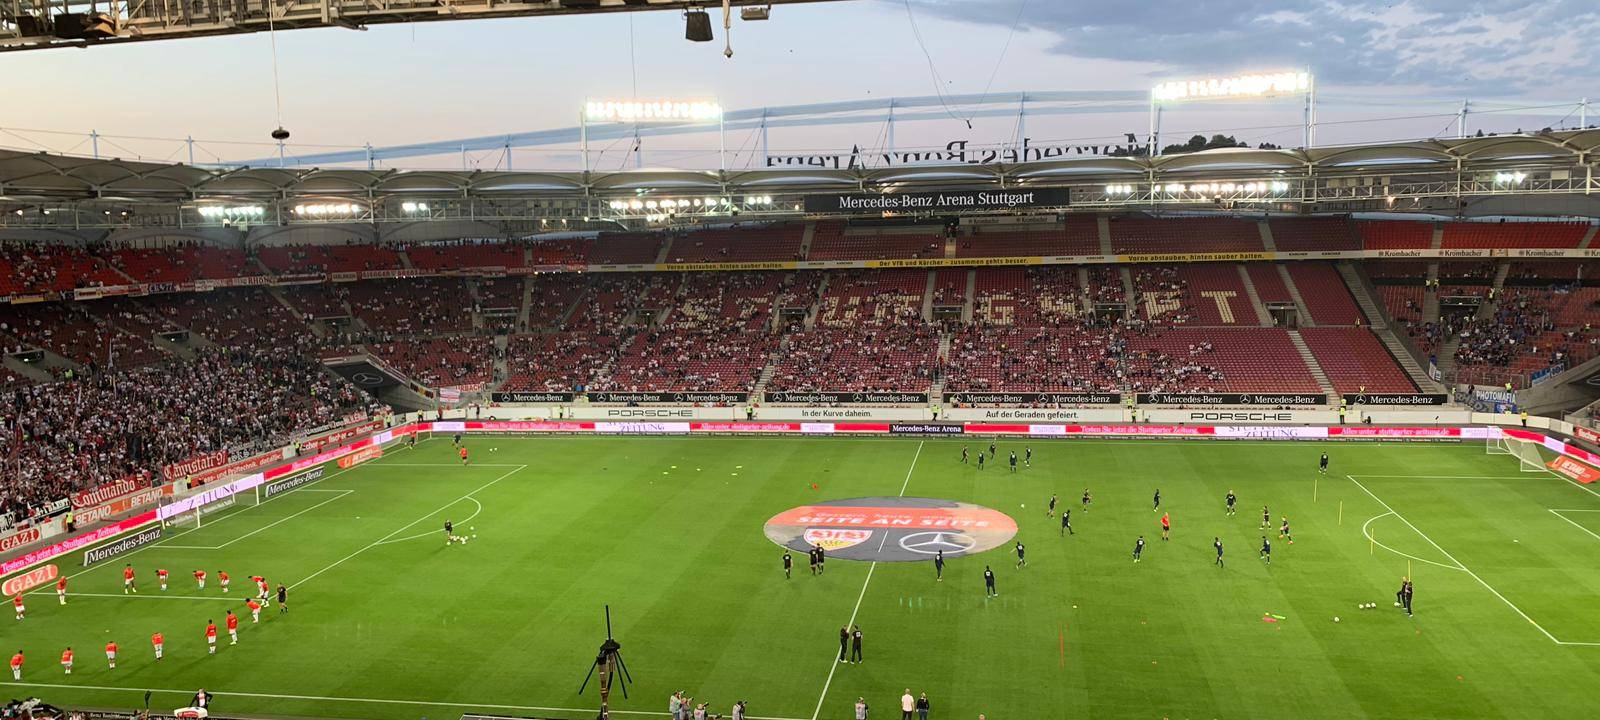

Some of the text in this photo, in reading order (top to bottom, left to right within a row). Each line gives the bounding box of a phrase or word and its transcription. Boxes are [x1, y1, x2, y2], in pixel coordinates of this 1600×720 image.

[839, 192, 1034, 209] Mercedes-Benz Arena Stuttgart
[514, 394, 563, 402] Mercedes-Benz
[610, 394, 660, 402] Mercedes-Benz
[687, 394, 738, 402] Mercedes-Benz
[785, 394, 838, 402] Mercedes-Benz
[866, 394, 920, 402] Mercedes-Benz
[966, 395, 1022, 403] Mercedes-Benz
[1052, 395, 1110, 403] Mercedes-Benz
[1163, 396, 1223, 404] Mercedes-Benz
[1254, 396, 1315, 404] Mercedes-Benz
[1370, 396, 1433, 405] Mercedes-Benz
[608, 410, 693, 418] PORSCHE
[802, 410, 872, 418] In der Kurve daheim.
[986, 410, 1079, 420] Auf der Geraden gefeiert.
[1191, 413, 1292, 421] PORSCHE
[269, 469, 323, 496] Mercedes-Benz
[72, 478, 136, 507] Commando
[131, 488, 163, 508] BETANO
[75, 505, 111, 526] BETANO
[798, 516, 990, 528] SEITE AN SEITE
[1, 531, 36, 550] GAZI
[2, 526, 121, 572] Testen Sie jetzt die Stuttgarter Zeitung
[88, 529, 161, 564] Mercedes-Benz
[11, 567, 52, 593] GAZI
